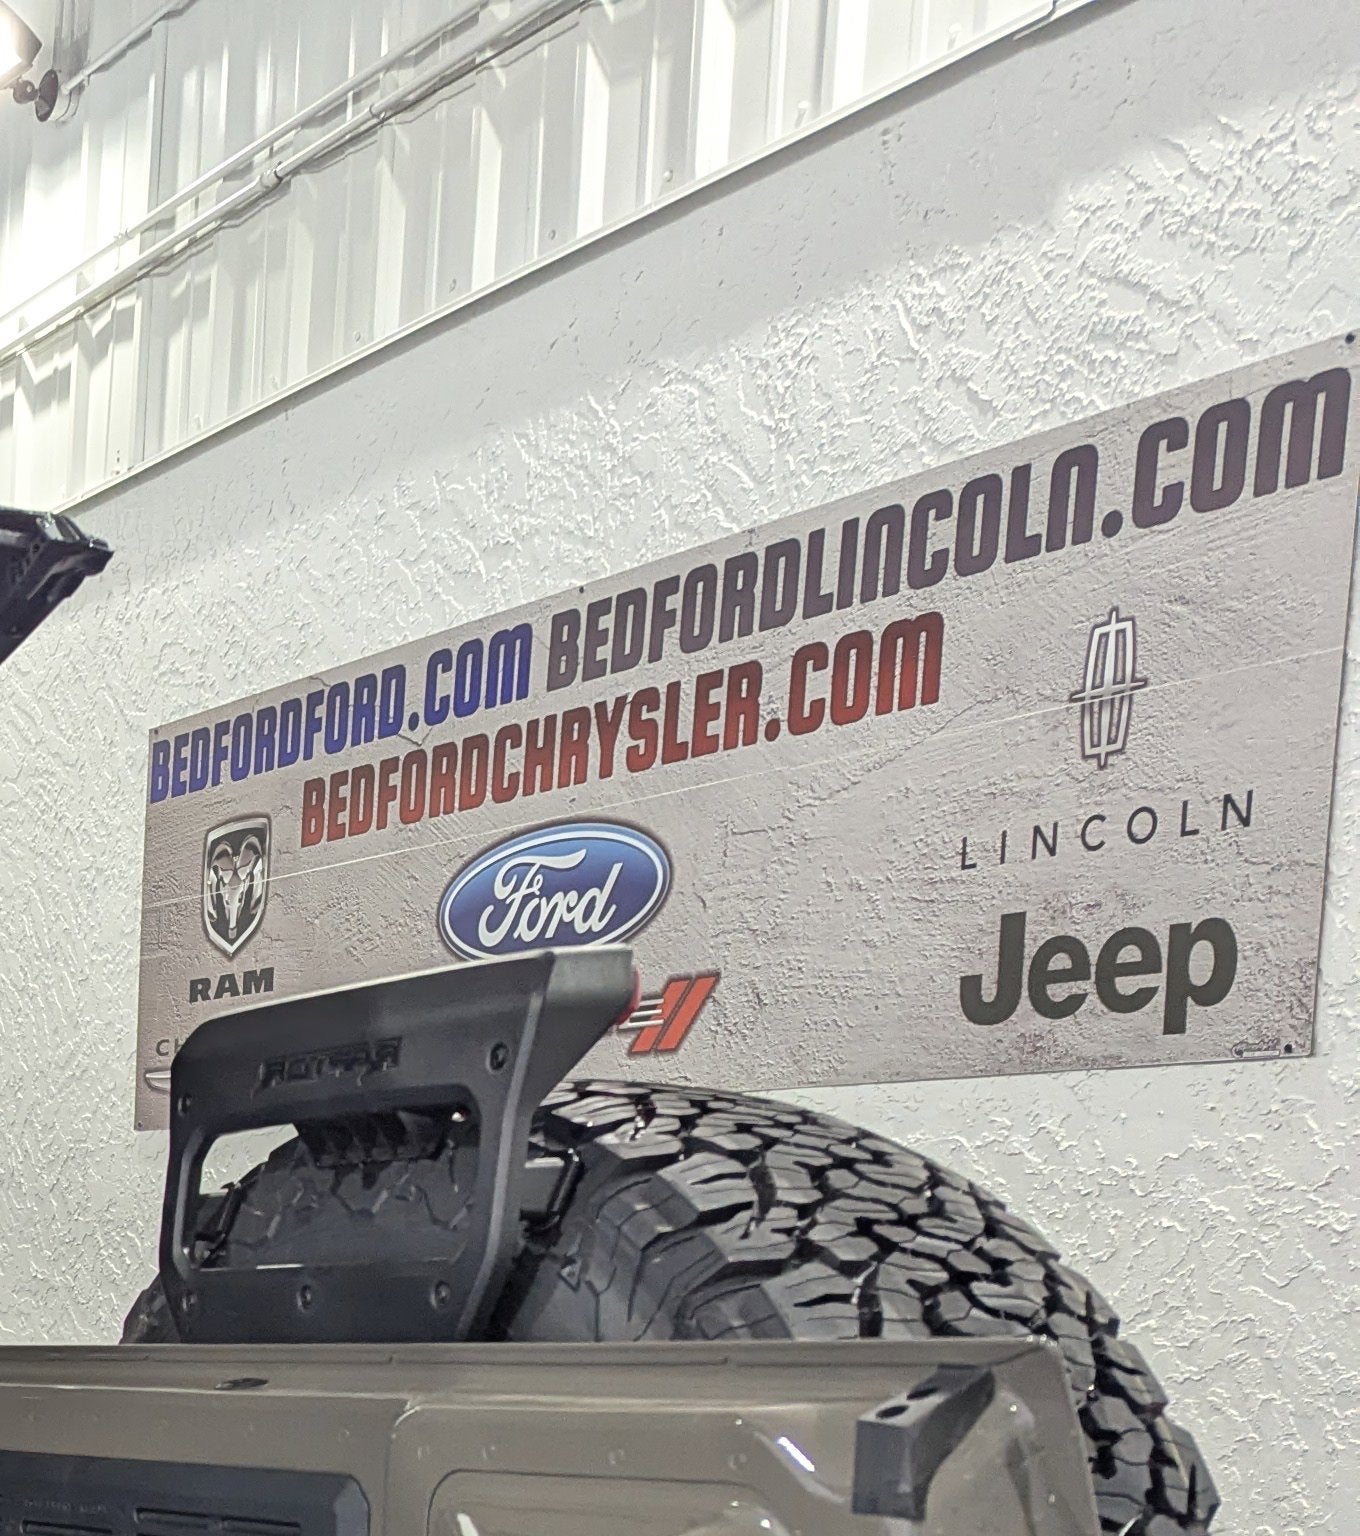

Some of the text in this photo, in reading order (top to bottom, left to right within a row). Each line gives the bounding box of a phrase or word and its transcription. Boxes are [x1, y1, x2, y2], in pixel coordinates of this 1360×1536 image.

[150, 366, 1352, 804] BEDFORDFORD.COM BEDFORDLINCOLN.COM
[301, 611, 945, 848] BEDFORDCHRYSLER.COM
[961, 789, 1254, 871] LINCOLN
[478, 848, 623, 948] Ford
[189, 966, 275, 1004] RAM
[959, 911, 1238, 1036] Jeep
